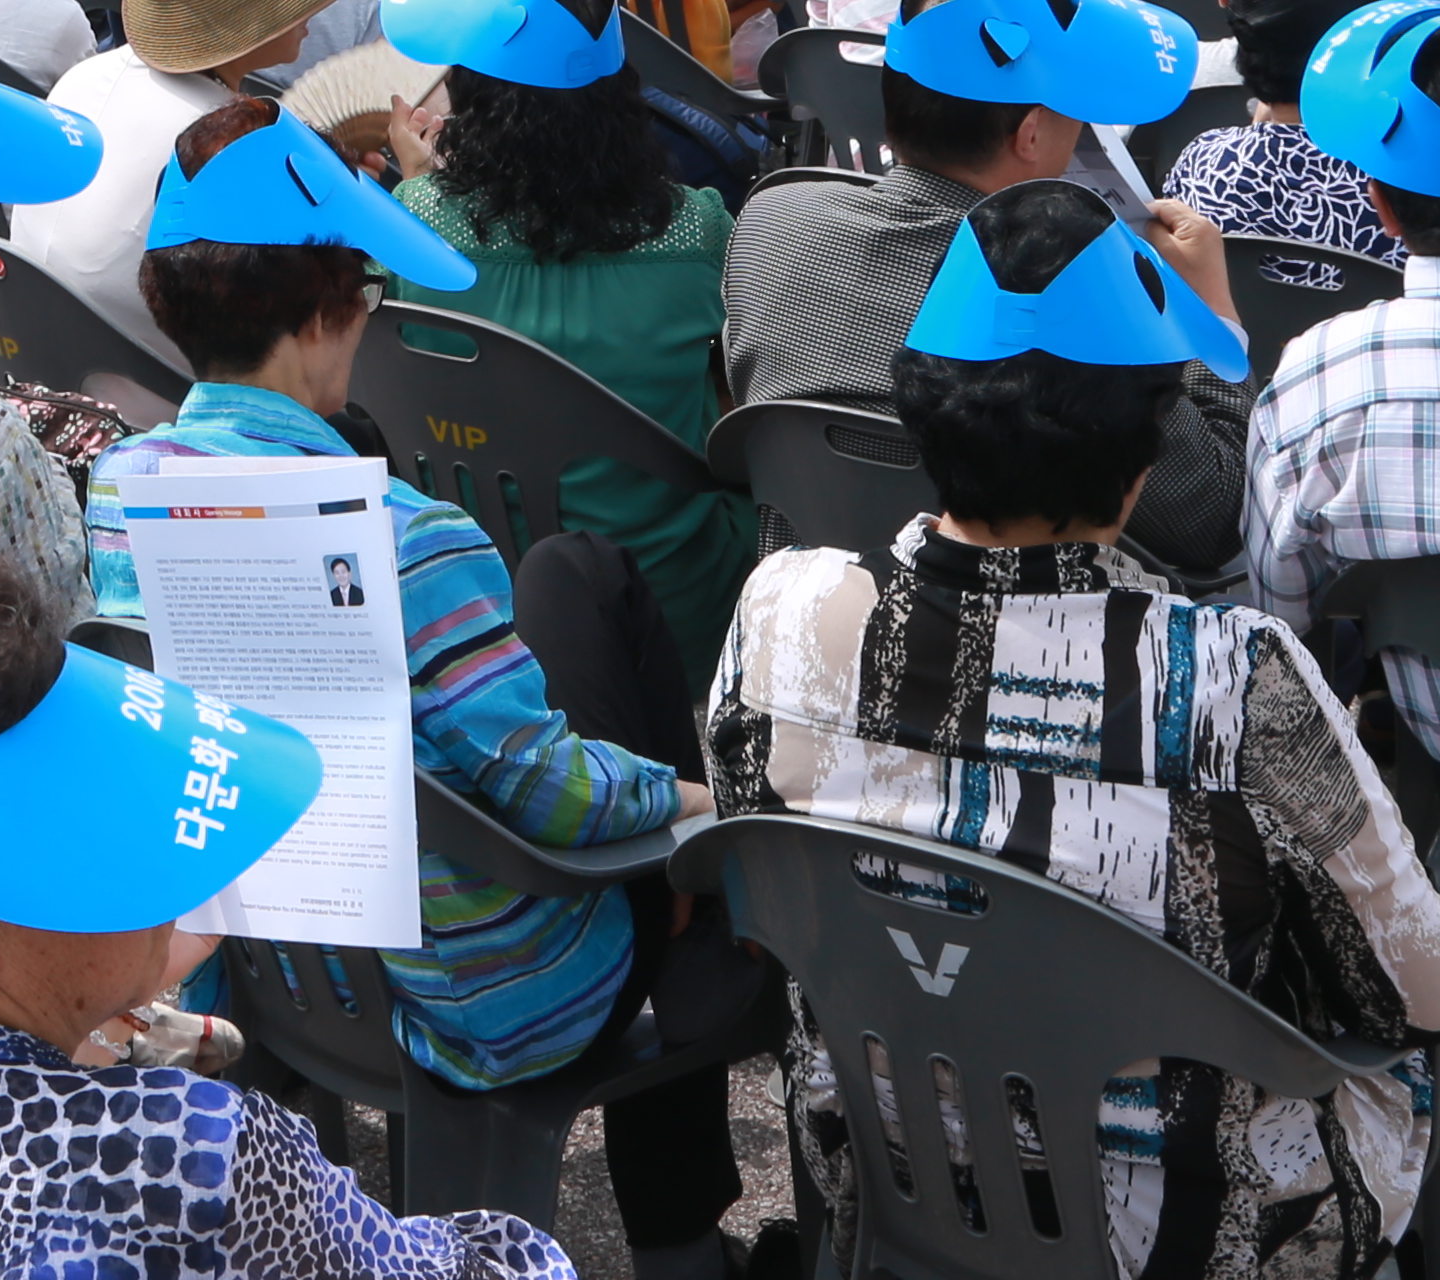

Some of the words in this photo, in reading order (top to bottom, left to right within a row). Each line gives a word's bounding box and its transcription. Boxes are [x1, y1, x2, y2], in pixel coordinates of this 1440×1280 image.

[1138, 8, 1177, 74] 다문화
[426, 415, 487, 450] VIP
[120, 666, 166, 732] 2016
[173, 734, 241, 852] 다문화
